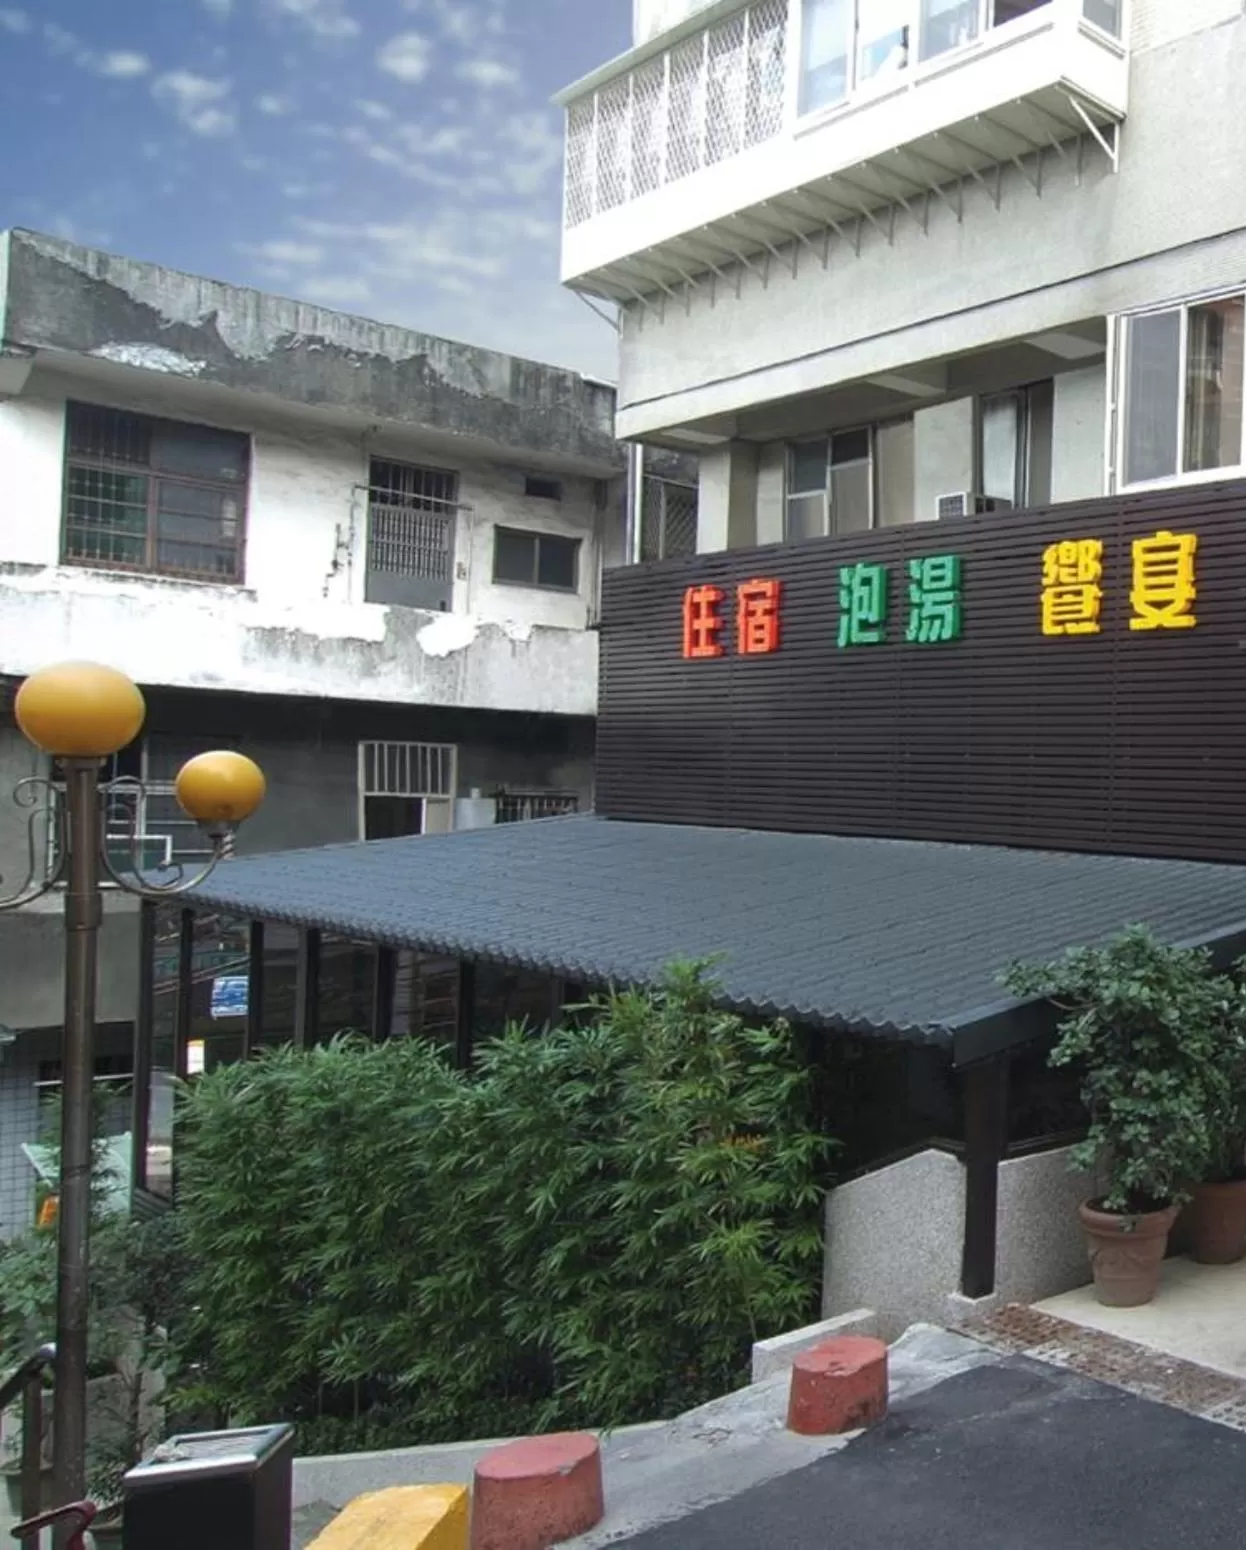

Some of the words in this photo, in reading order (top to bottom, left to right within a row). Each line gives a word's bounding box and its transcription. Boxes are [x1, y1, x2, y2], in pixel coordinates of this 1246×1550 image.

[681, 577, 781, 659] 住宿
[836, 553, 966, 648] 泡湯
[1040, 530, 1198, 636] 饗宴
